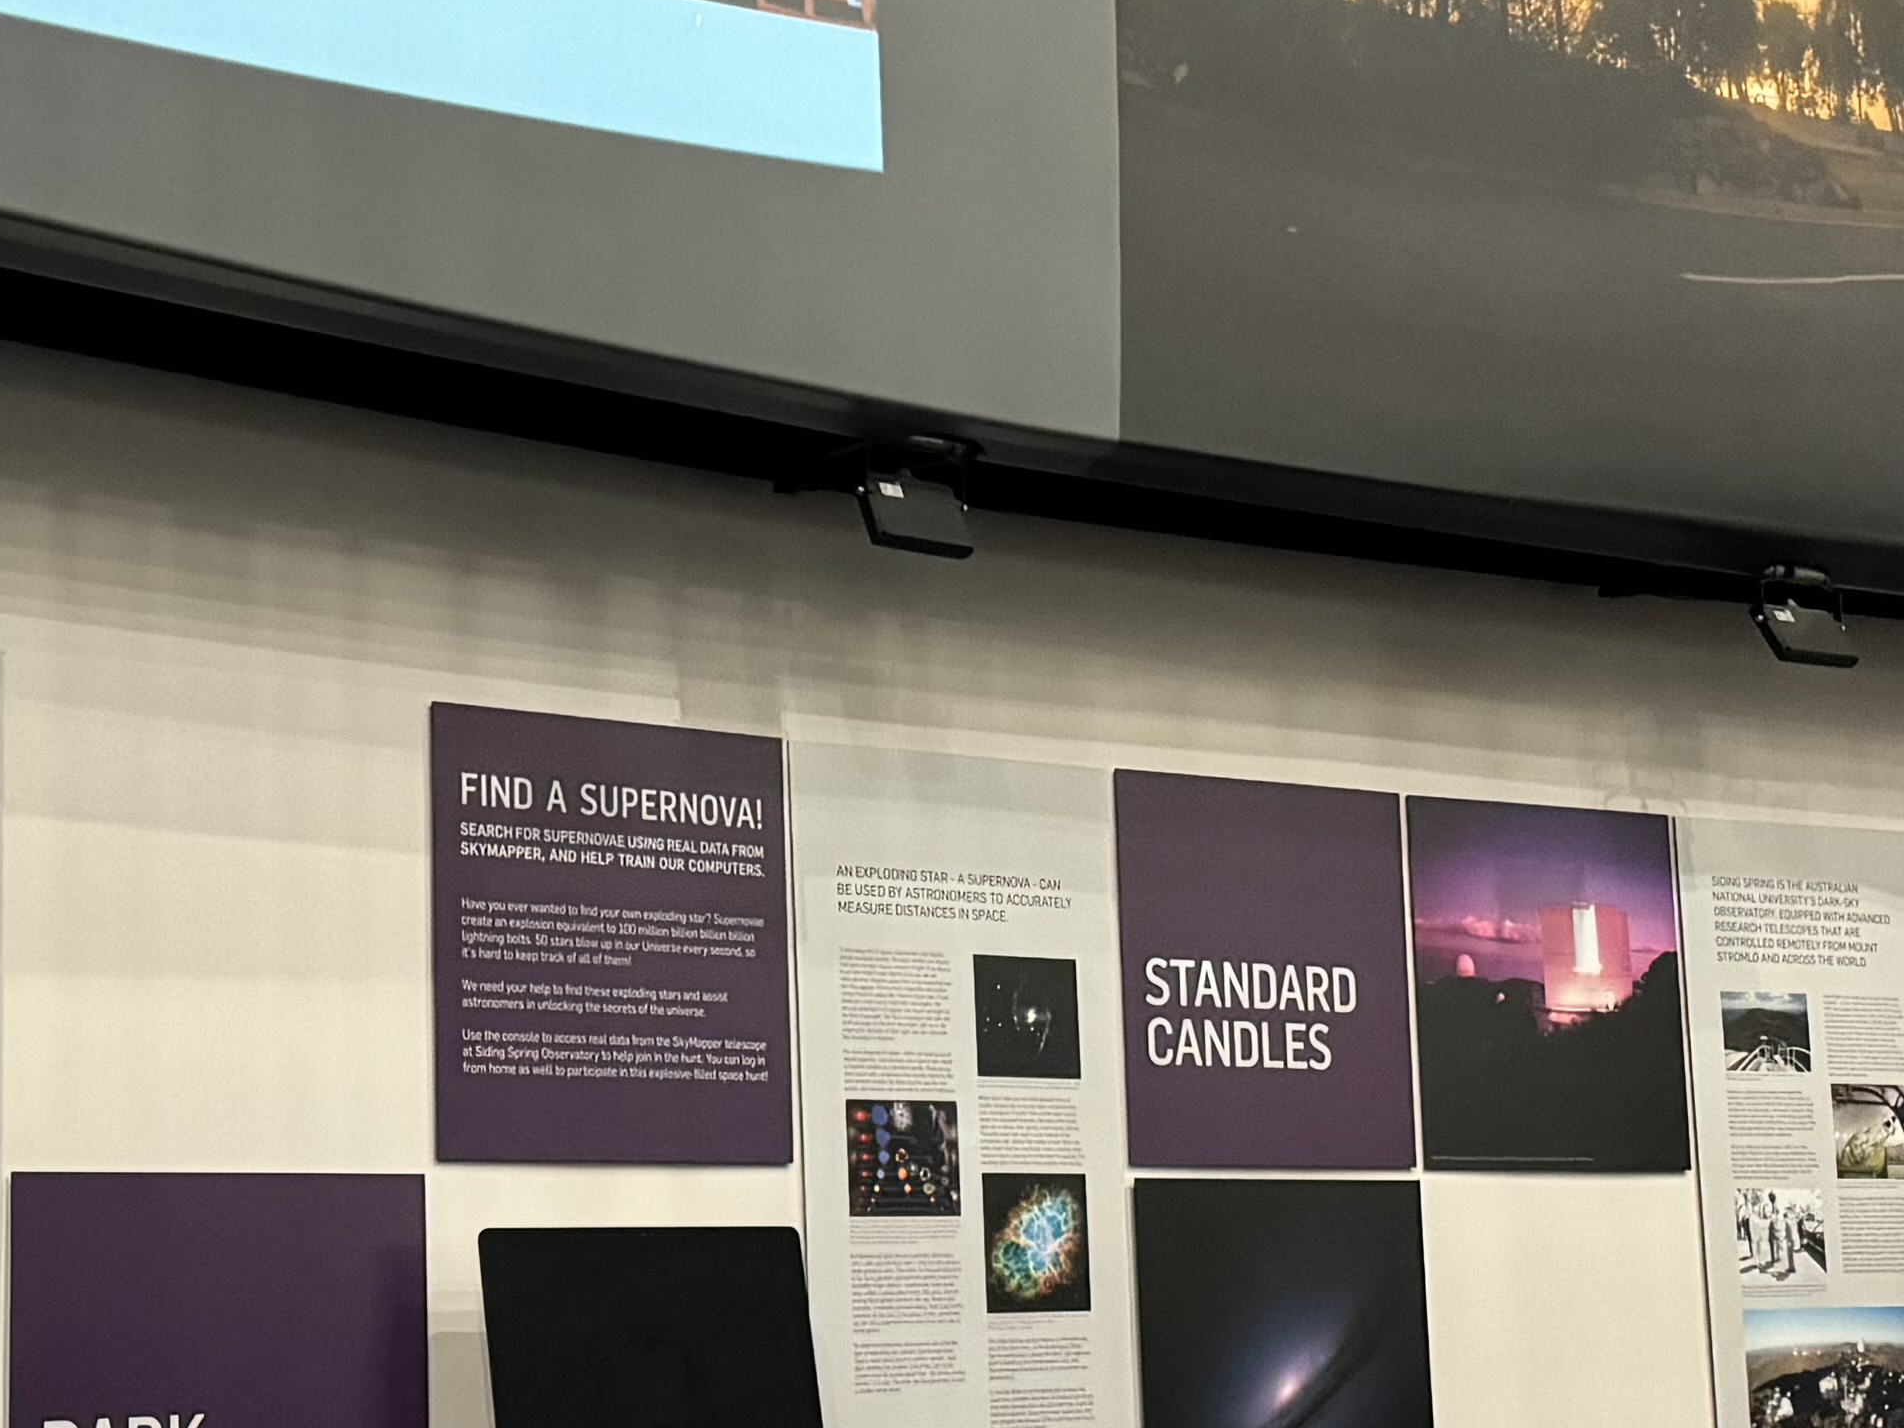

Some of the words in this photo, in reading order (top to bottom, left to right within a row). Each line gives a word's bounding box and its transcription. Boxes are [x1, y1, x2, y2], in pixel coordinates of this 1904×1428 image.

[461, 772, 532, 809] FIND
[547, 779, 566, 812] A
[580, 783, 762, 829] SUPERNOVA!
[459, 821, 513, 838] SEARCH
[514, 826, 541, 840] FOR
[543, 828, 625, 847] SUPERNOVAE
[627, 835, 665, 850] USING
[666, 838, 697, 853] REAL
[699, 840, 730, 855] DATA
[731, 843, 764, 858] FROM
[549, 848, 577, 862] AND
[580, 850, 614, 865] HELP
[616, 853, 655, 868] TRAIN
[658, 856, 685, 870] OUR
[836, 865, 853, 876] AN
[854, 865, 918, 881] EXPLODING
[920, 869, 948, 883] STAR
[957, 873, 965, 883] A
[967, 873, 1030, 888] SUPERNOVA
[1038, 878, 1061, 890] CAN
[1710, 875, 1741, 887] SIDING
[1742, 877, 1775, 889] SPRING
[1775, 878, 1785, 890] IS
[1785, 878, 1803, 890] THE
[1805, 880, 1858, 893] AUSTRALIAN
[836, 882, 852, 895] BE
[854, 883, 886, 897] USED
[887, 885, 902, 898] BY
[904, 886, 987, 903] ASTRONOMERS
[989, 891, 1003, 904] TO
[1006, 893, 1071, 909] ACCURATELY
[1711, 891, 1756, 902] NATIONAL
[837, 900, 893, 915] MEASURE
[894, 903, 956, 918] DISTANCES
[958, 907, 969, 919] IN
[1778, 908, 1821, 921] EQUIPPED
[1822, 911, 1845, 921] WITH
[1846, 912, 1891, 924] ADVANCED
[1713, 920, 1762, 933] RESEARCH
[1763, 922, 1819, 935] TELESCOPES
[1819, 925, 1843, 935] THAT
[1843, 926, 1860, 937] ARE
[1715, 935, 1774, 948] CONTROLLED
[1775, 938, 1821, 950] REMOTELY
[1822, 940, 1847, 951] FROM
[1847, 941, 1879, 952] MOUNT
[1760, 952, 1780, 963] AND
[1781, 953, 1816, 964] ACROSS
[1816, 954, 1834, 965] THE
[461, 979, 478, 991] We
[478, 980, 504, 992] need
[505, 983, 527, 994] your
[528, 983, 551, 995] help
[552, 984, 563, 994] to
[564, 983, 583, 995] find
[583, 986, 611, 996] these
[611, 987, 657, 1000] exploding
[657, 989, 682, 1000] stars
[682, 990, 700, 1000] and
[1145, 957, 1357, 1013] STANDARD
[461, 997, 525, 1009] astronomers
[525, 999, 536, 1009] in
[536, 1000, 584, 1012] unlocking
[584, 1001, 601, 1012] the
[602, 1003, 637, 1013] secrets
[637, 1003, 648, 1014] of
[649, 1004, 665, 1015] the
[1147, 1016, 1332, 1071] CANDLES
